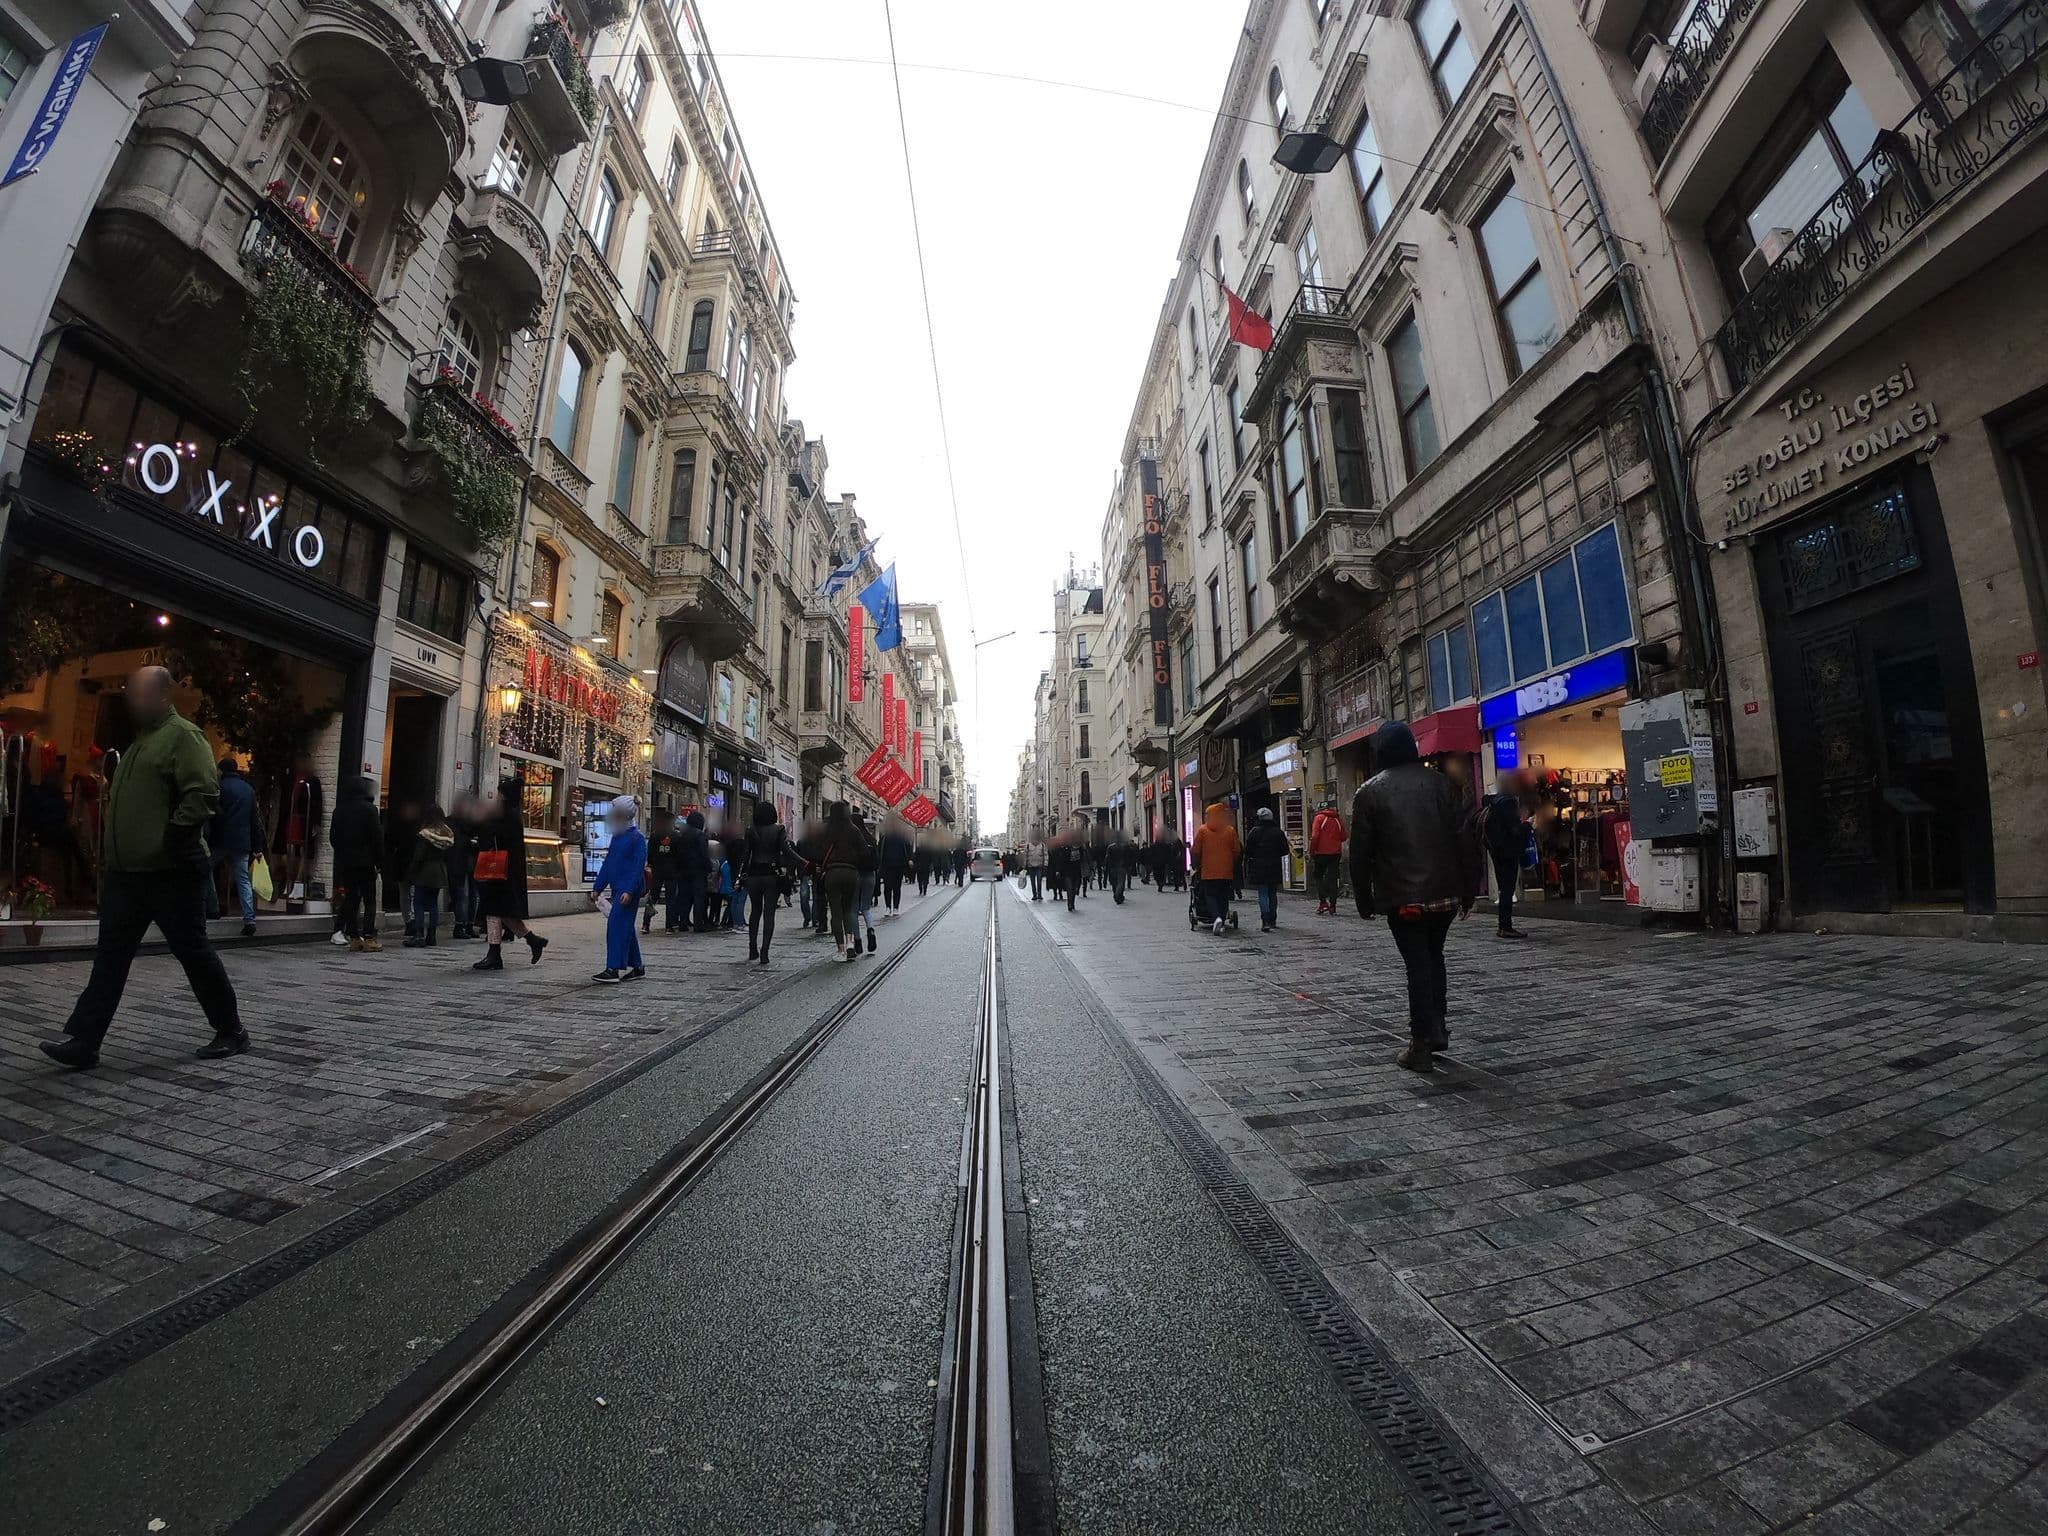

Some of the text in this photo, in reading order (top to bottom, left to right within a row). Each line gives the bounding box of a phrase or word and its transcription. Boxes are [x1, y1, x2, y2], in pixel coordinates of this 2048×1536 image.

[1780, 388, 1823, 421] T.C.
[1829, 362, 1915, 432] İLÇESİ
[1833, 400, 1939, 474] KONAĞI
[141, 443, 324, 568] OXXO
[1144, 494, 1161, 534] FLO
[1149, 565, 1165, 608] FLO
[1154, 640, 1169, 684] FLO
[1516, 674, 1569, 716] NBB
[1497, 741, 1515, 750] NBB
[1662, 757, 1687, 769] FOTO
